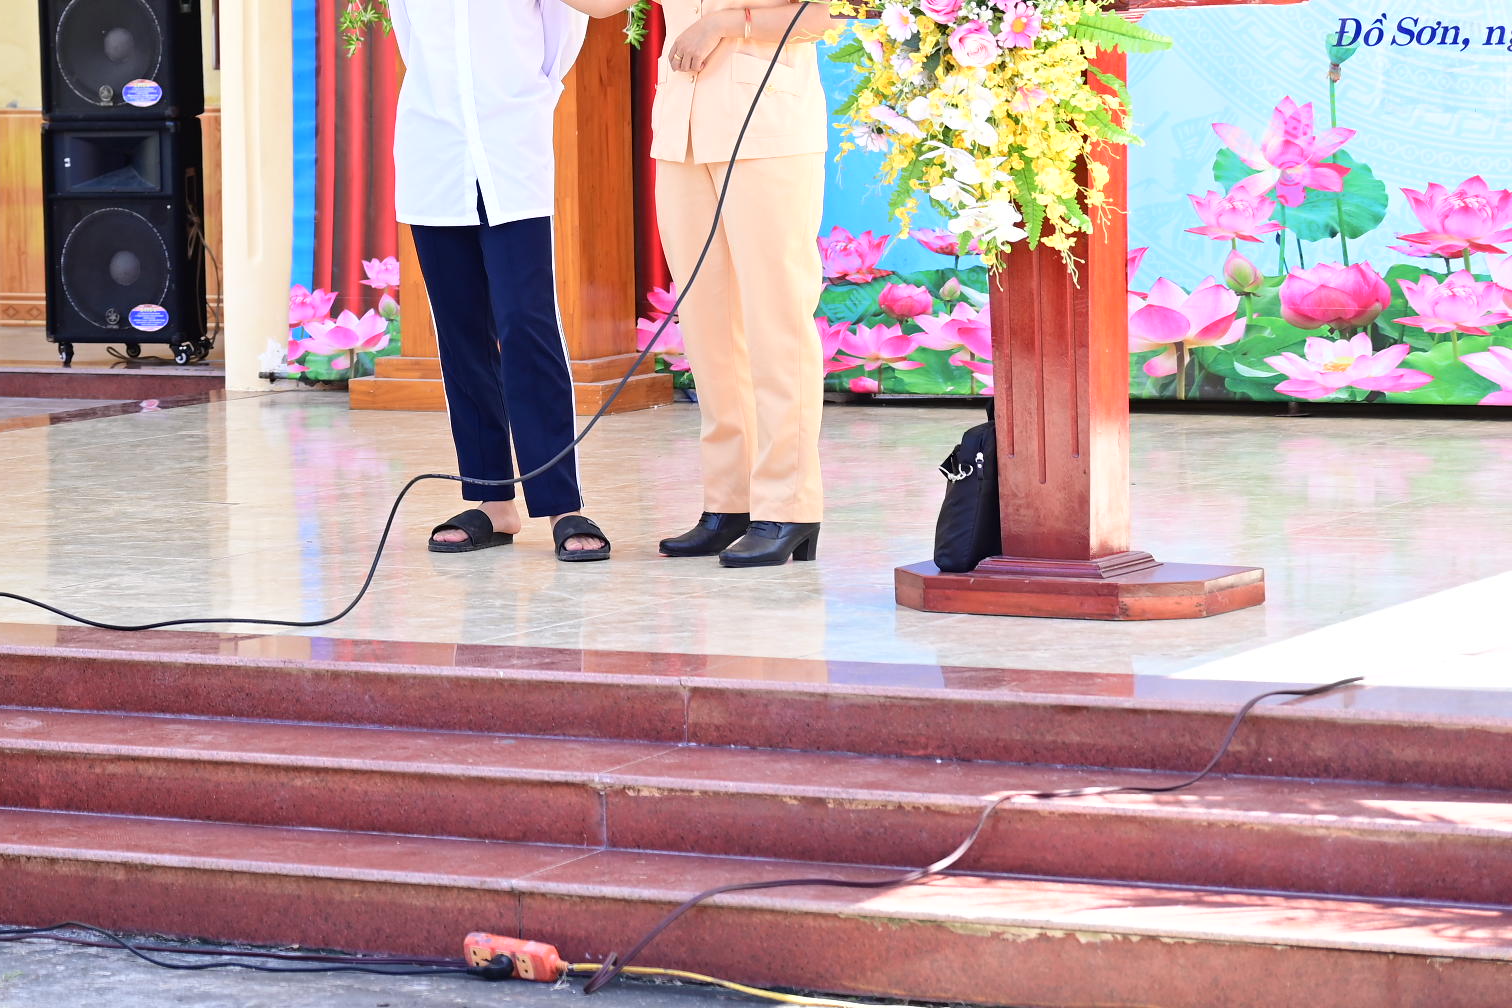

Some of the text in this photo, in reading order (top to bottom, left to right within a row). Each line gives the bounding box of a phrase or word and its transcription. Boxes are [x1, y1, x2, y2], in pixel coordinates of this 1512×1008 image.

[1333, 12, 1512, 52] Đồ Sơn, n
